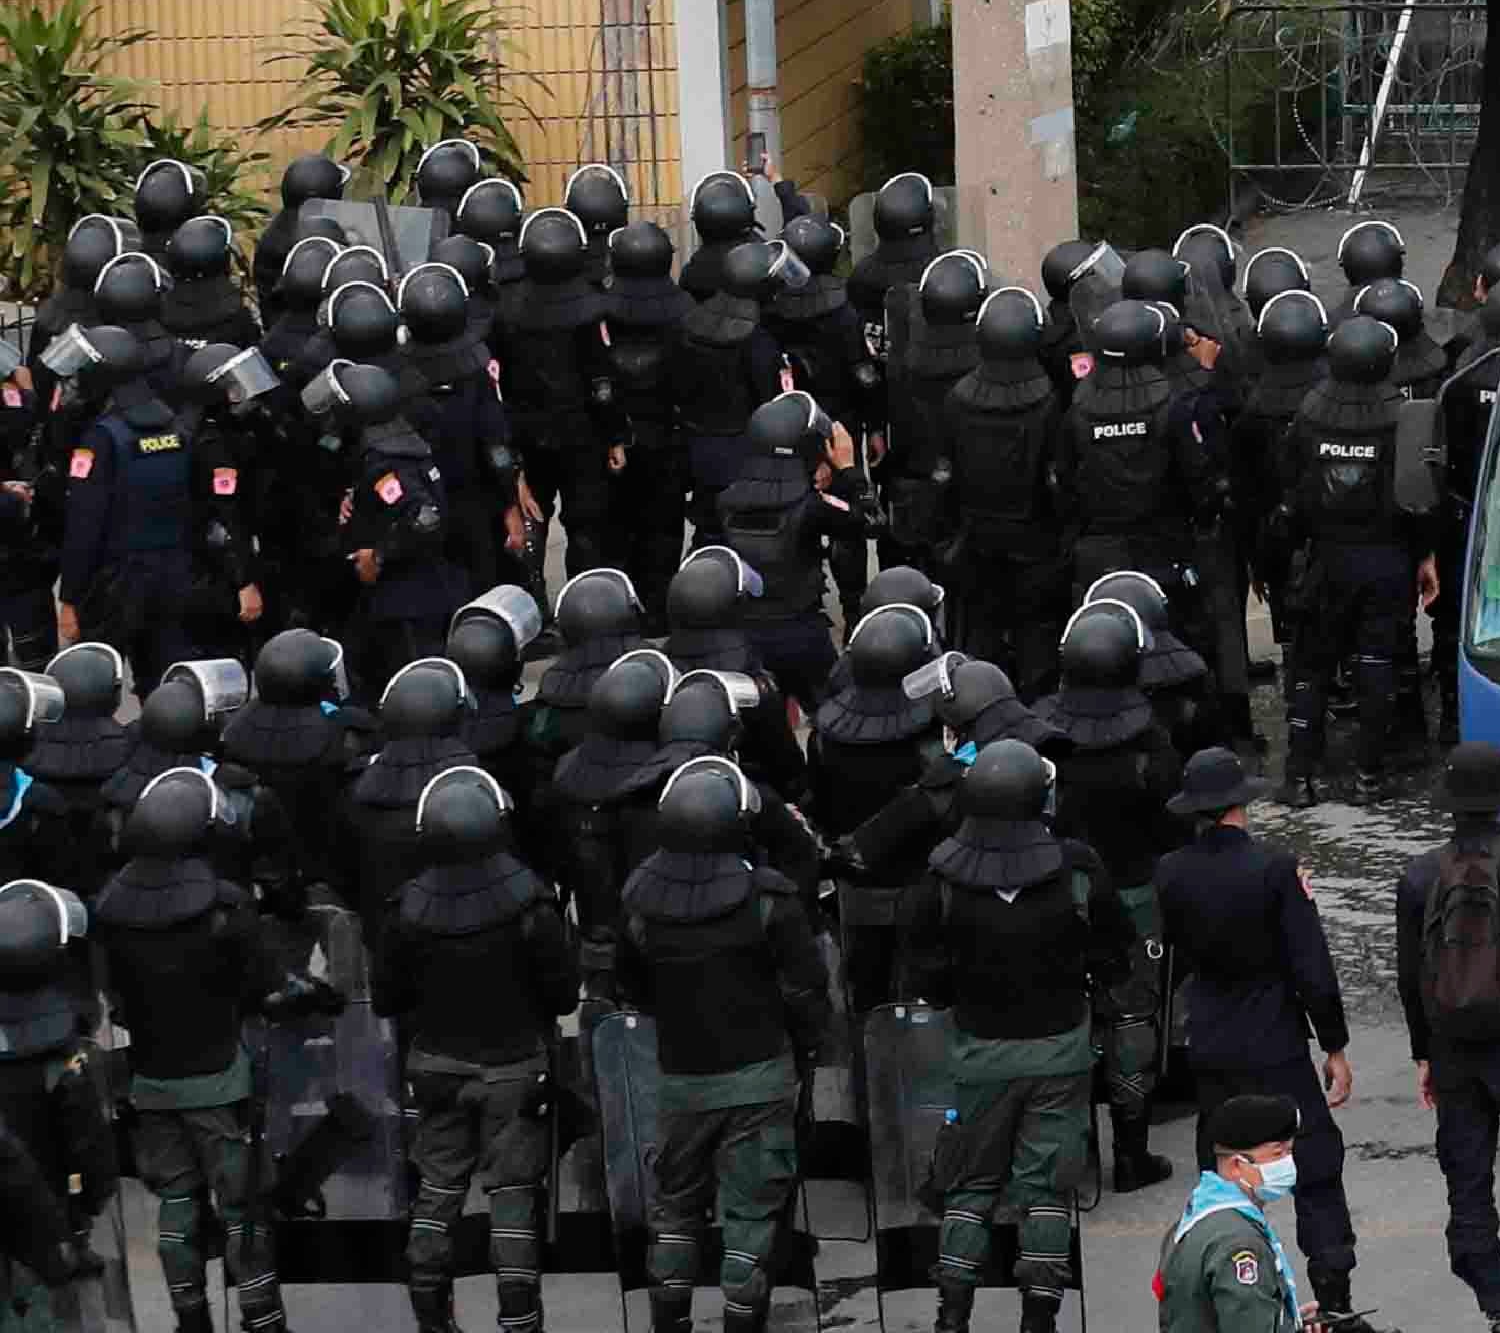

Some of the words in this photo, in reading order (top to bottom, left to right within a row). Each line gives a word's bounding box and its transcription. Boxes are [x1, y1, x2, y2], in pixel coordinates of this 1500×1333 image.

[1094, 421, 1147, 440] POLICE
[139, 435, 181, 454] POLICE
[1319, 442, 1377, 459] POLICE
